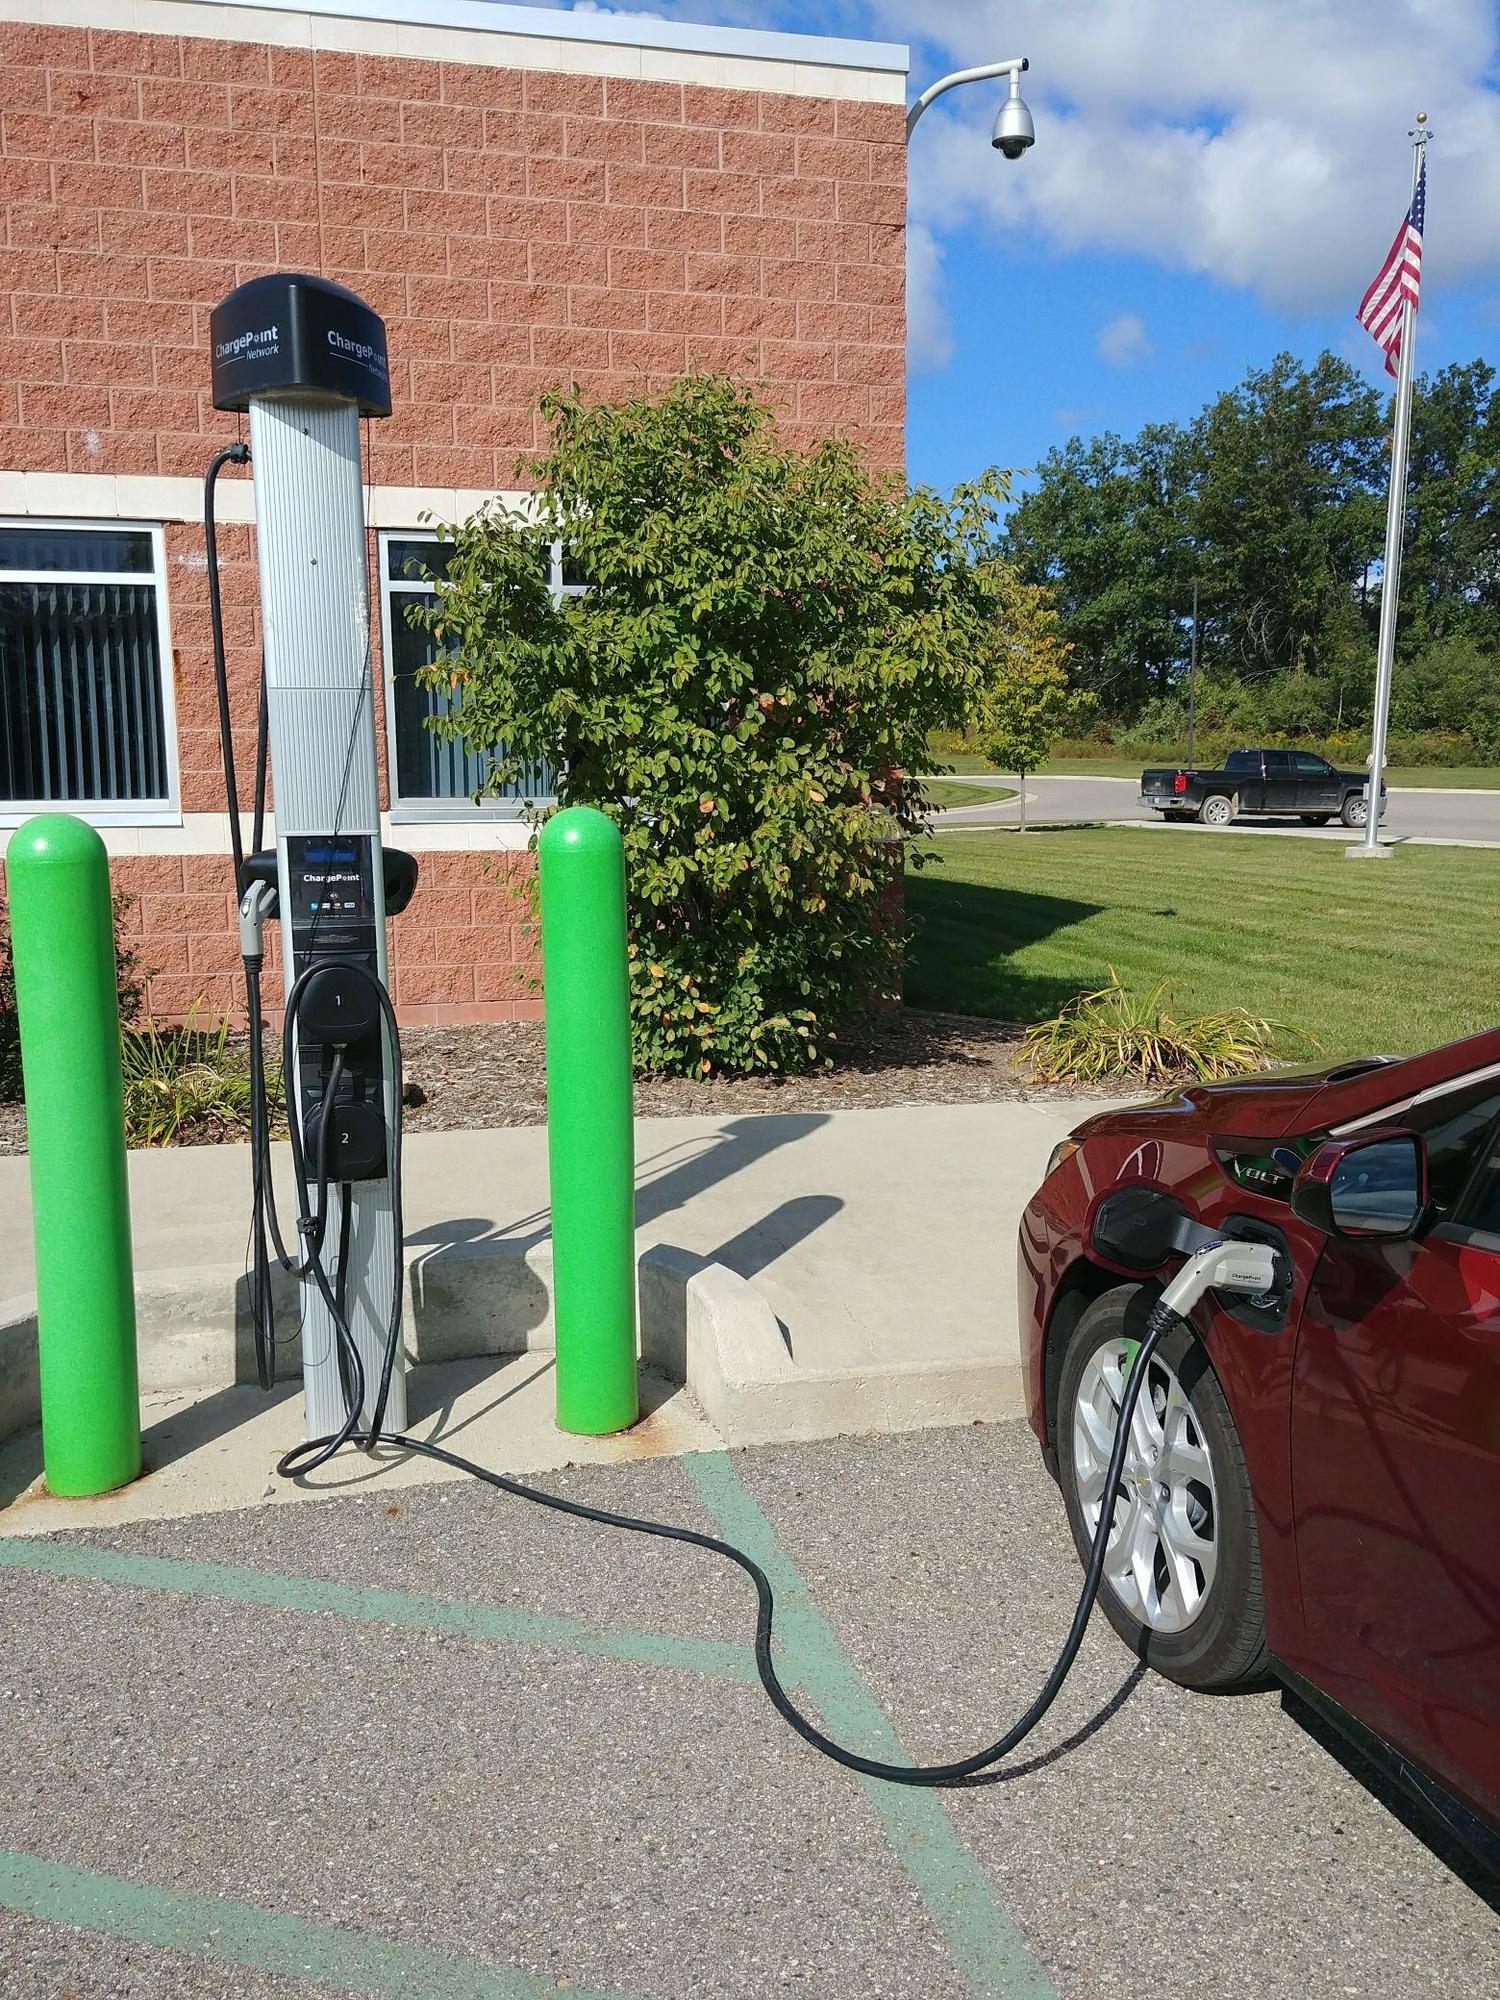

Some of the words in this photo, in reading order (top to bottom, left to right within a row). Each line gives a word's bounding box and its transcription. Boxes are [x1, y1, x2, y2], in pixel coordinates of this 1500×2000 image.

[215, 325, 279, 358] ChargePoint
[246, 343, 279, 360] Network
[303, 873, 360, 883] ChargePoint
[335, 995, 341, 1006] 1
[341, 1132, 349, 1144] 2
[1234, 1159, 1285, 1184] VOLT
